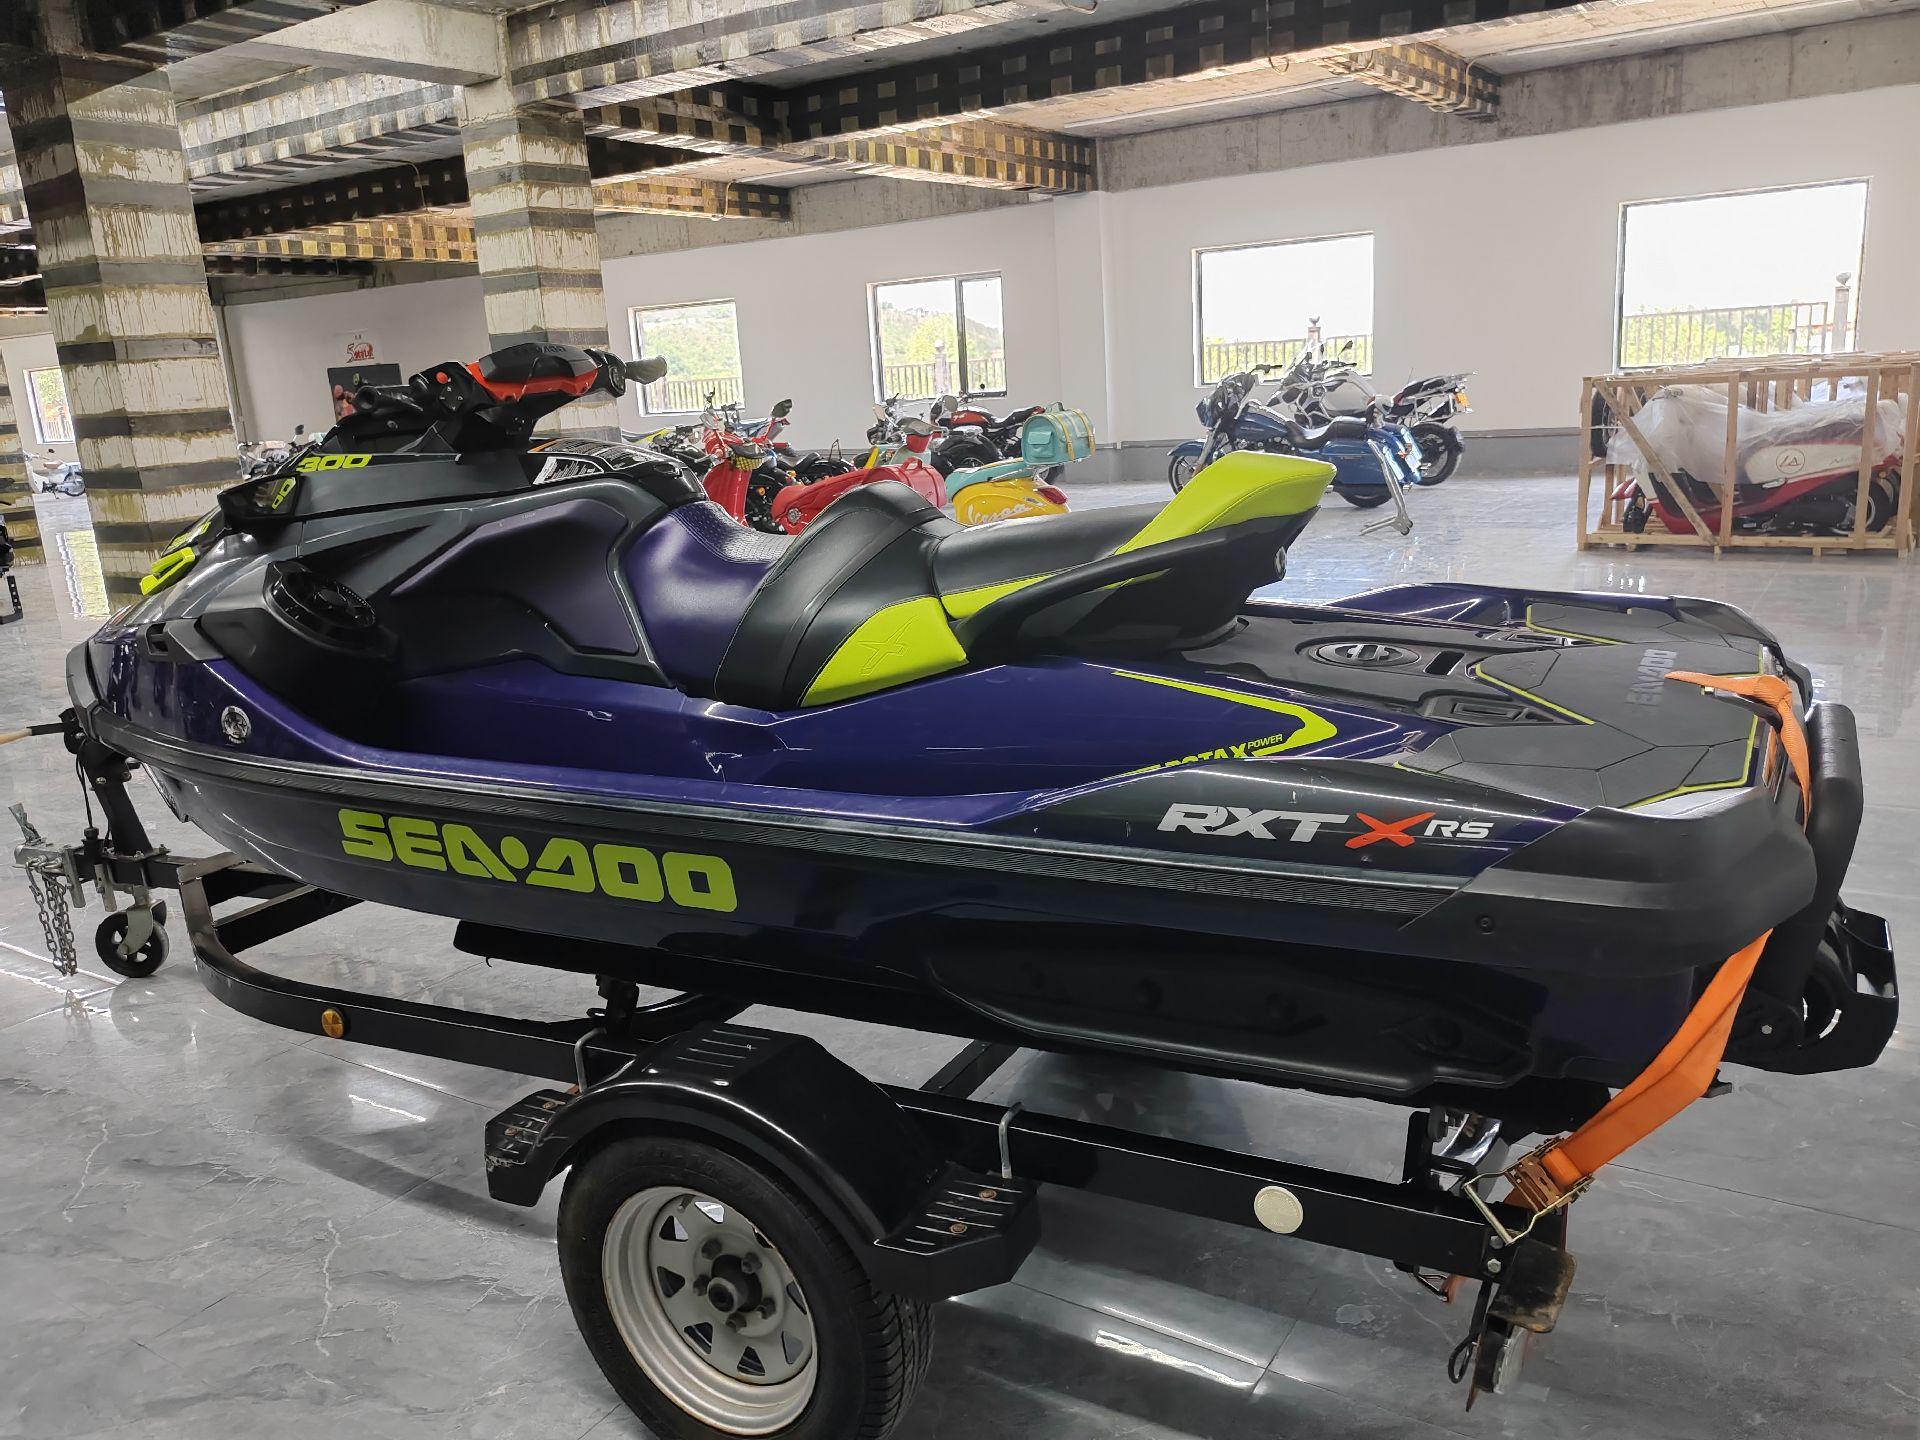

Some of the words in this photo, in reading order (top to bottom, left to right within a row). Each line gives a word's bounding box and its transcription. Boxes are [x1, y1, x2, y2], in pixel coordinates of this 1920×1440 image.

[296, 454, 373, 473] 300
[1247, 733, 1283, 750] POWER
[1157, 803, 1350, 843] RXT
[1345, 812, 1436, 848] X
[1424, 819, 1494, 839] RS
